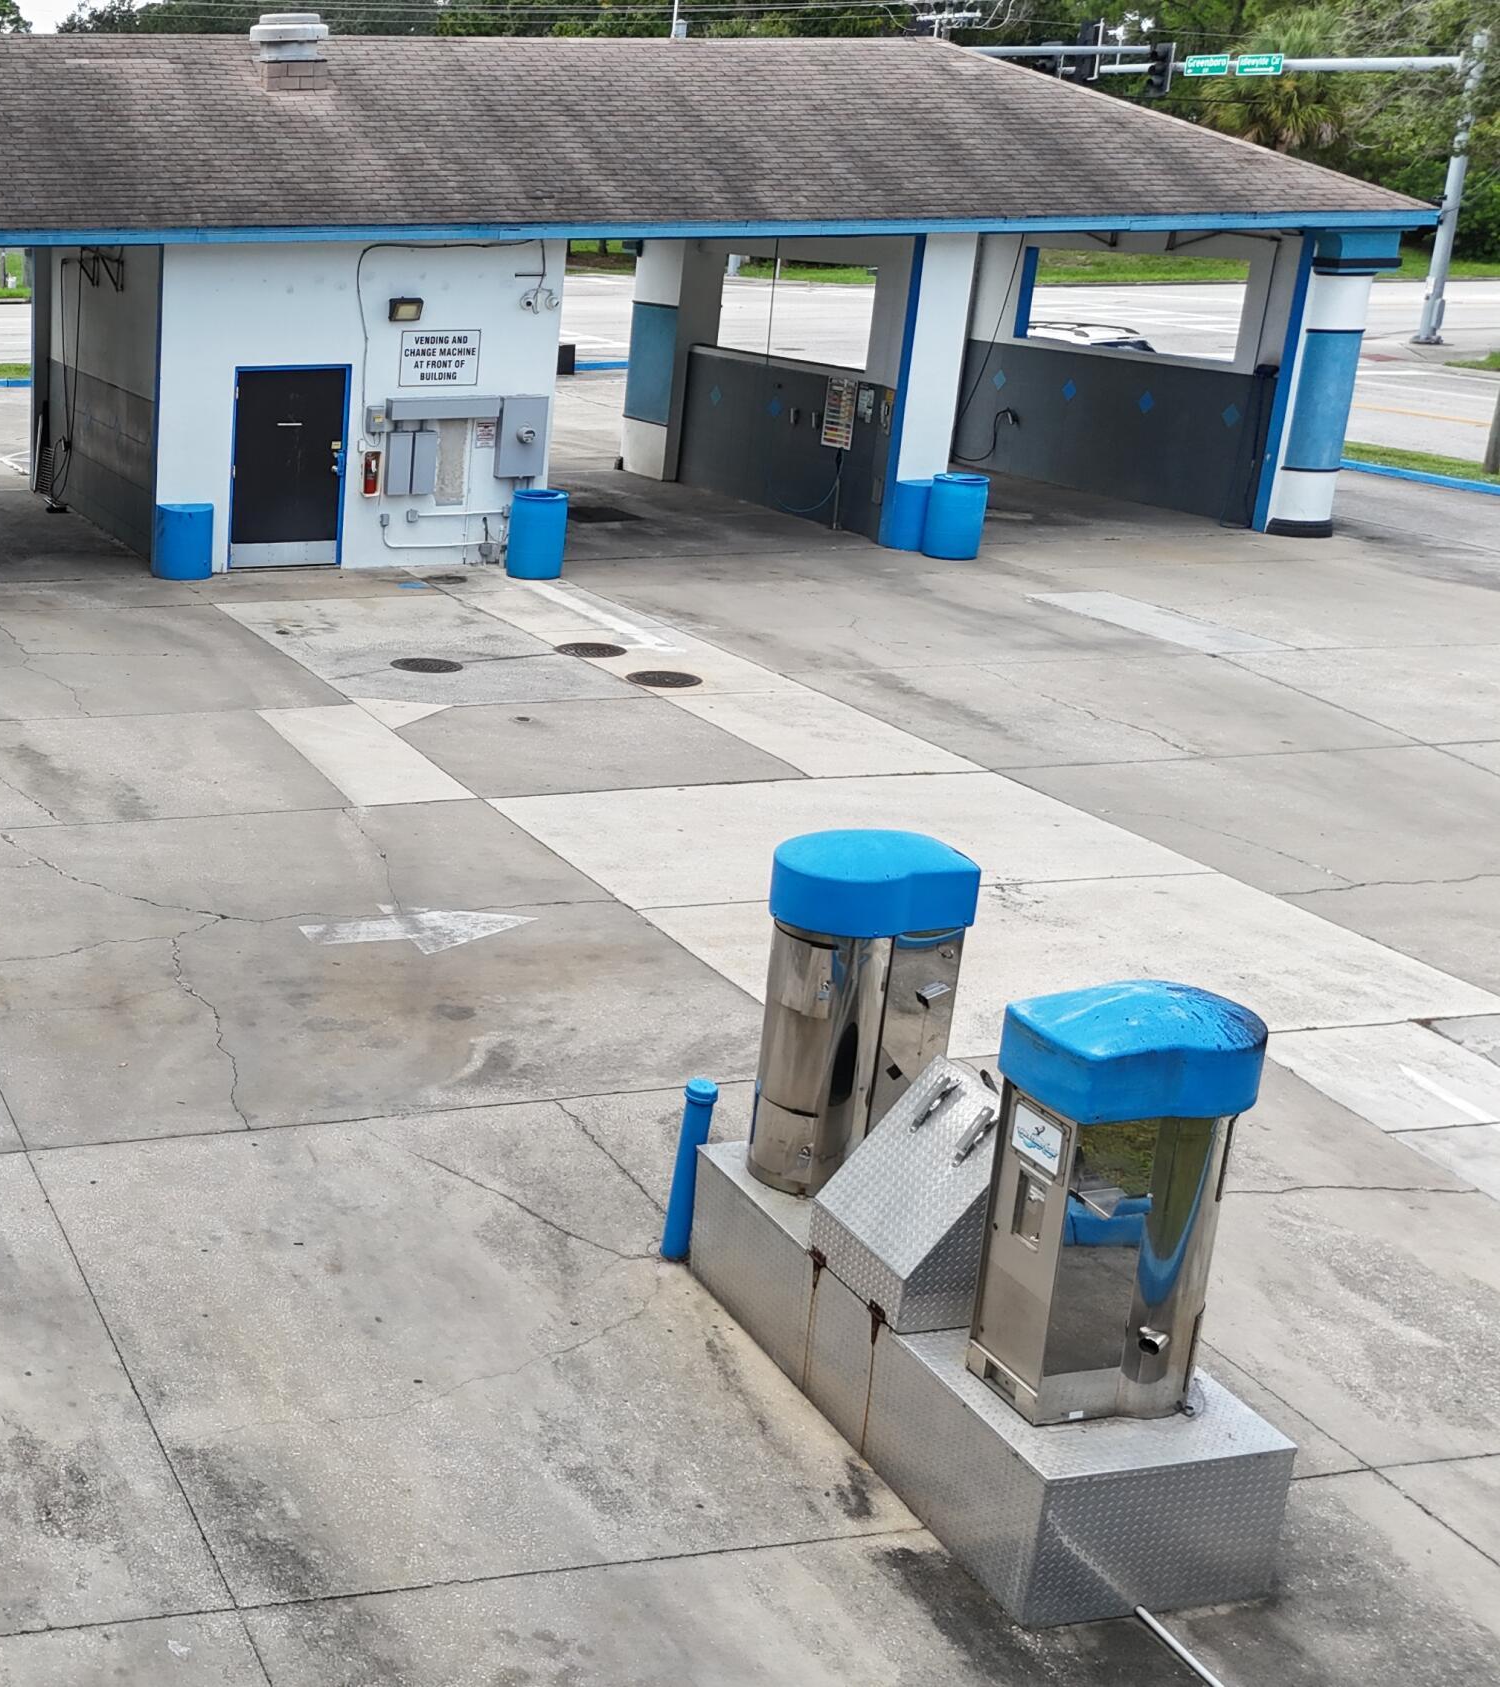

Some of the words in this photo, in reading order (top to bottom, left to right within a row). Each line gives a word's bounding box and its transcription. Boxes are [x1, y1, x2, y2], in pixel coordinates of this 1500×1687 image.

[1187, 58, 1227, 68] Greenboro
[414, 336, 449, 345] VENDING
[451, 335, 468, 344] AND
[404, 348, 437, 357] CHANGE
[438, 347, 477, 356] MACHINE
[413, 360, 425, 369] AT
[426, 360, 453, 369] FRONT
[454, 359, 466, 368] OF
[420, 372, 457, 381] BUILDING
